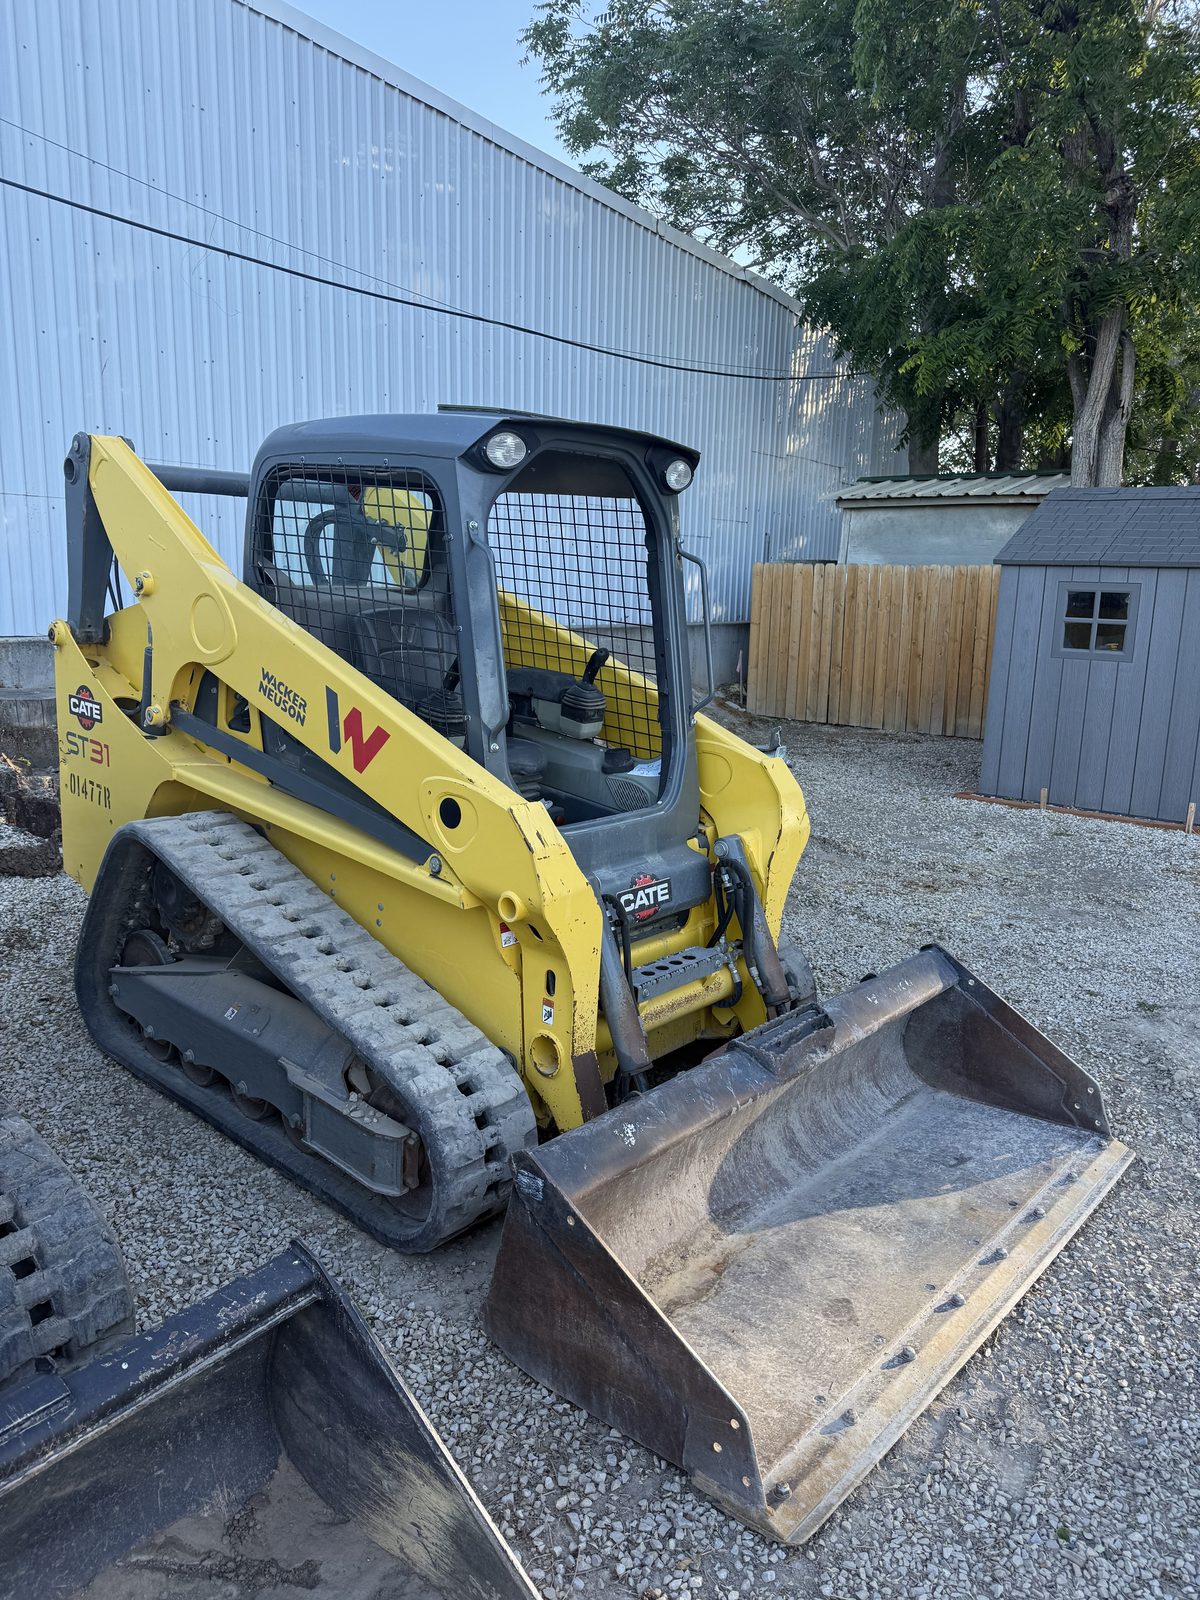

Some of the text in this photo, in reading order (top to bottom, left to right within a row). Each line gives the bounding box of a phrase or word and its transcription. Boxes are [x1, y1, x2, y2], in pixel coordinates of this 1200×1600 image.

[70, 697, 101, 720] CATE
[258, 680, 306, 727] NEUSON
[261, 666, 307, 714] WACKER
[66, 731, 110, 768] ST31
[620, 882, 670, 912] CATE
